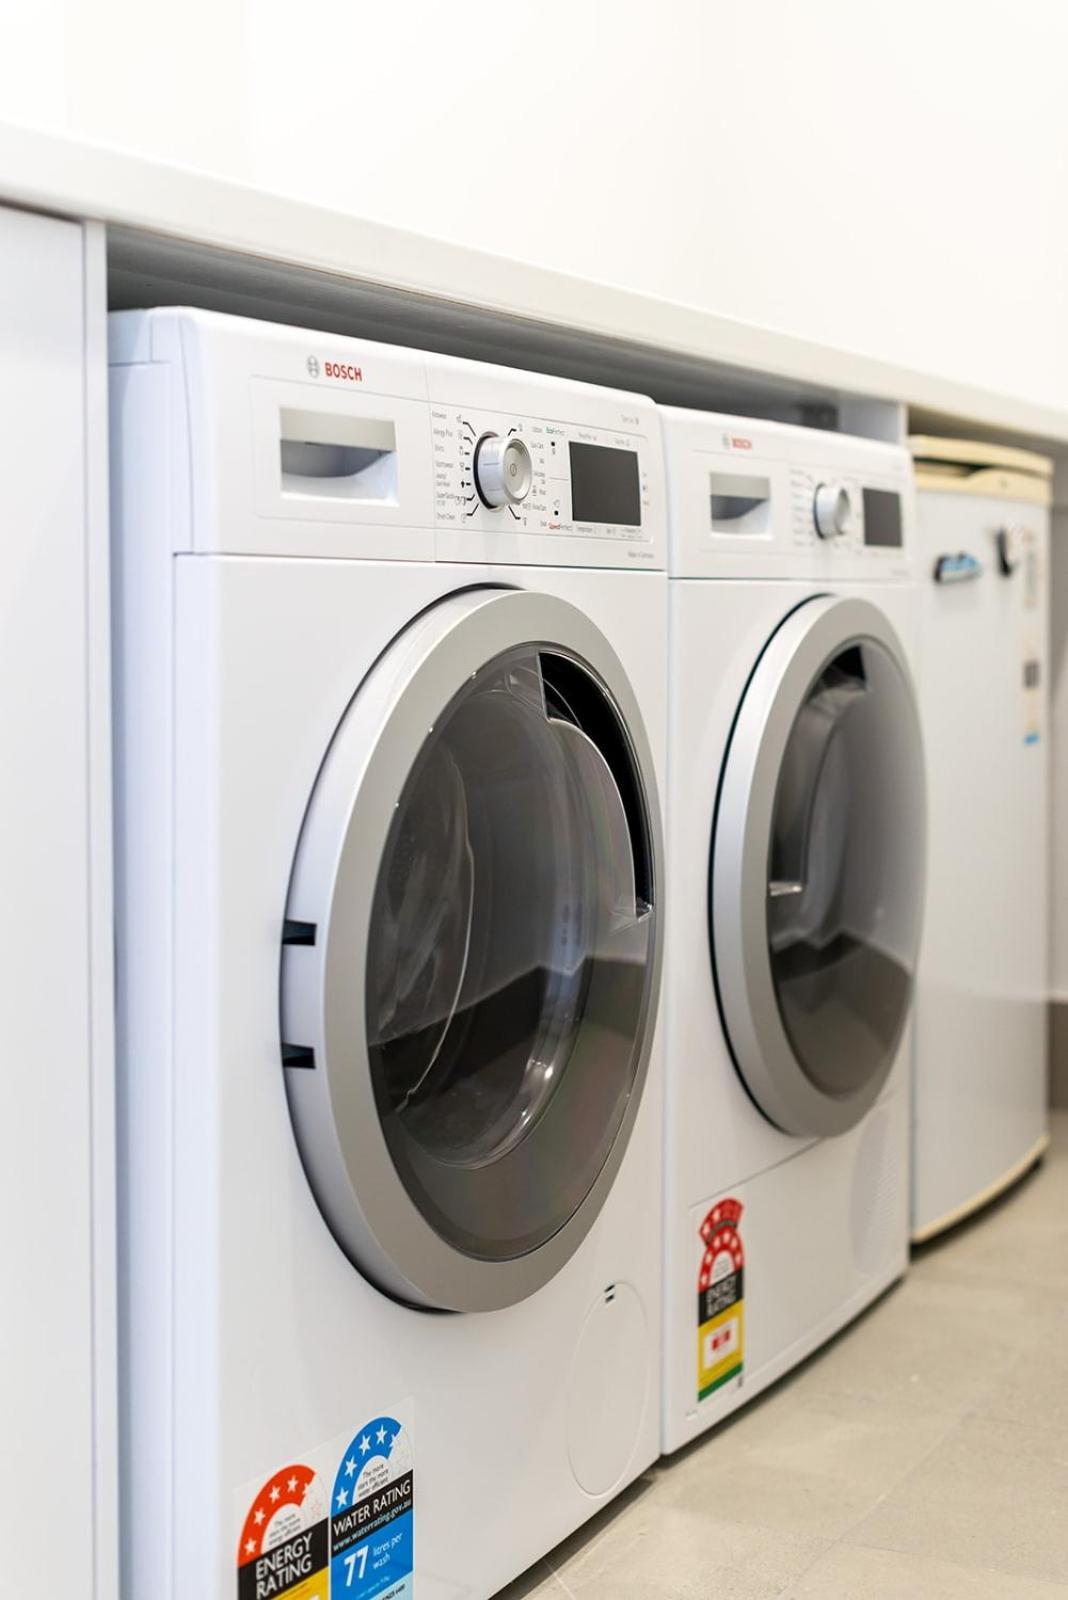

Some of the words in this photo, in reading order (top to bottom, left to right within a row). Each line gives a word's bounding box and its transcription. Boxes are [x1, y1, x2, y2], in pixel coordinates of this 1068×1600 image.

[324, 362, 363, 381] BOSCH
[333, 1504, 371, 1537] WATER
[373, 1479, 411, 1514] RATING
[333, 1498, 412, 1551] www.waterrating.gov.au
[255, 1532, 313, 1580] ENERGY
[256, 1553, 312, 1600] RATING
[344, 1544, 369, 1588] 77
[372, 1540, 391, 1557] litres
[391, 1532, 404, 1549] per
[372, 1552, 391, 1570] wash
